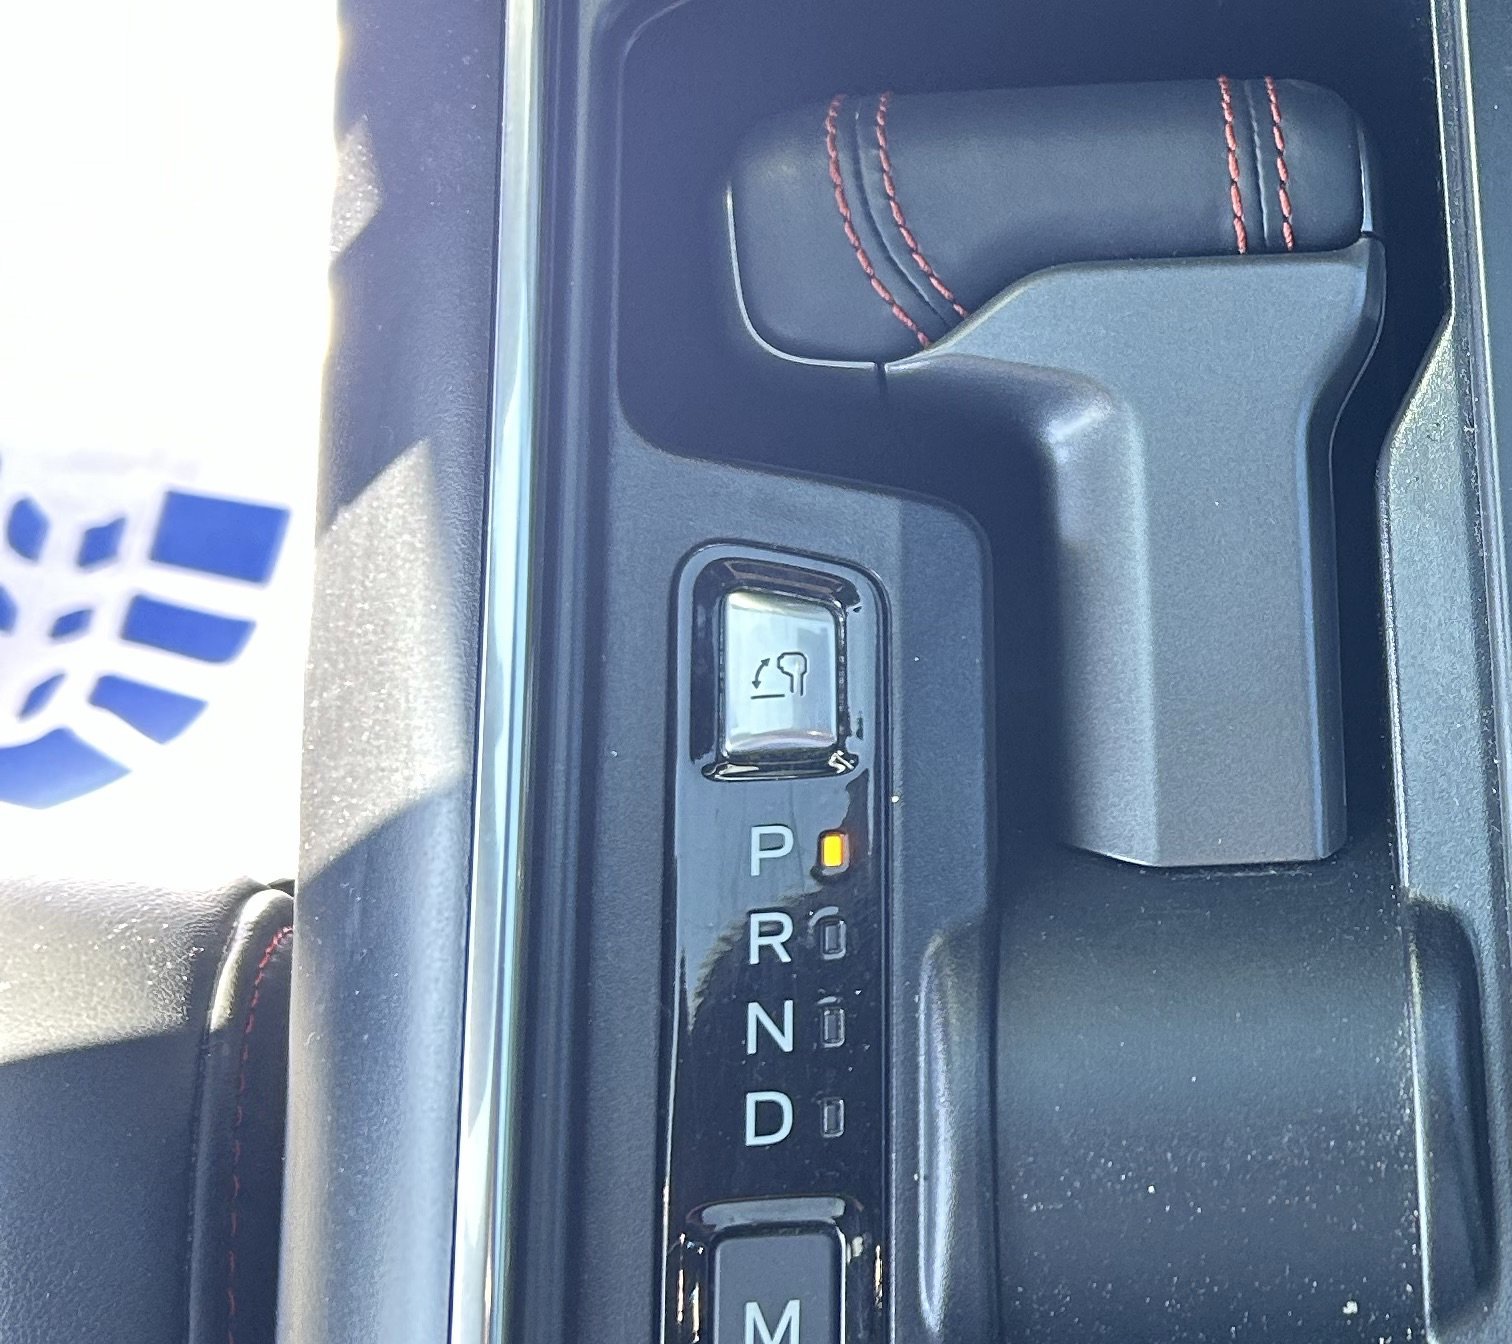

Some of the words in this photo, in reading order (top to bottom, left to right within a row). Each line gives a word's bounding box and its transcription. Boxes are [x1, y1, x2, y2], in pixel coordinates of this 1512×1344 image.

[749, 823, 794, 877] P
[747, 910, 793, 965] R
[745, 1000, 794, 1054] N
[744, 1092, 793, 1148] D
